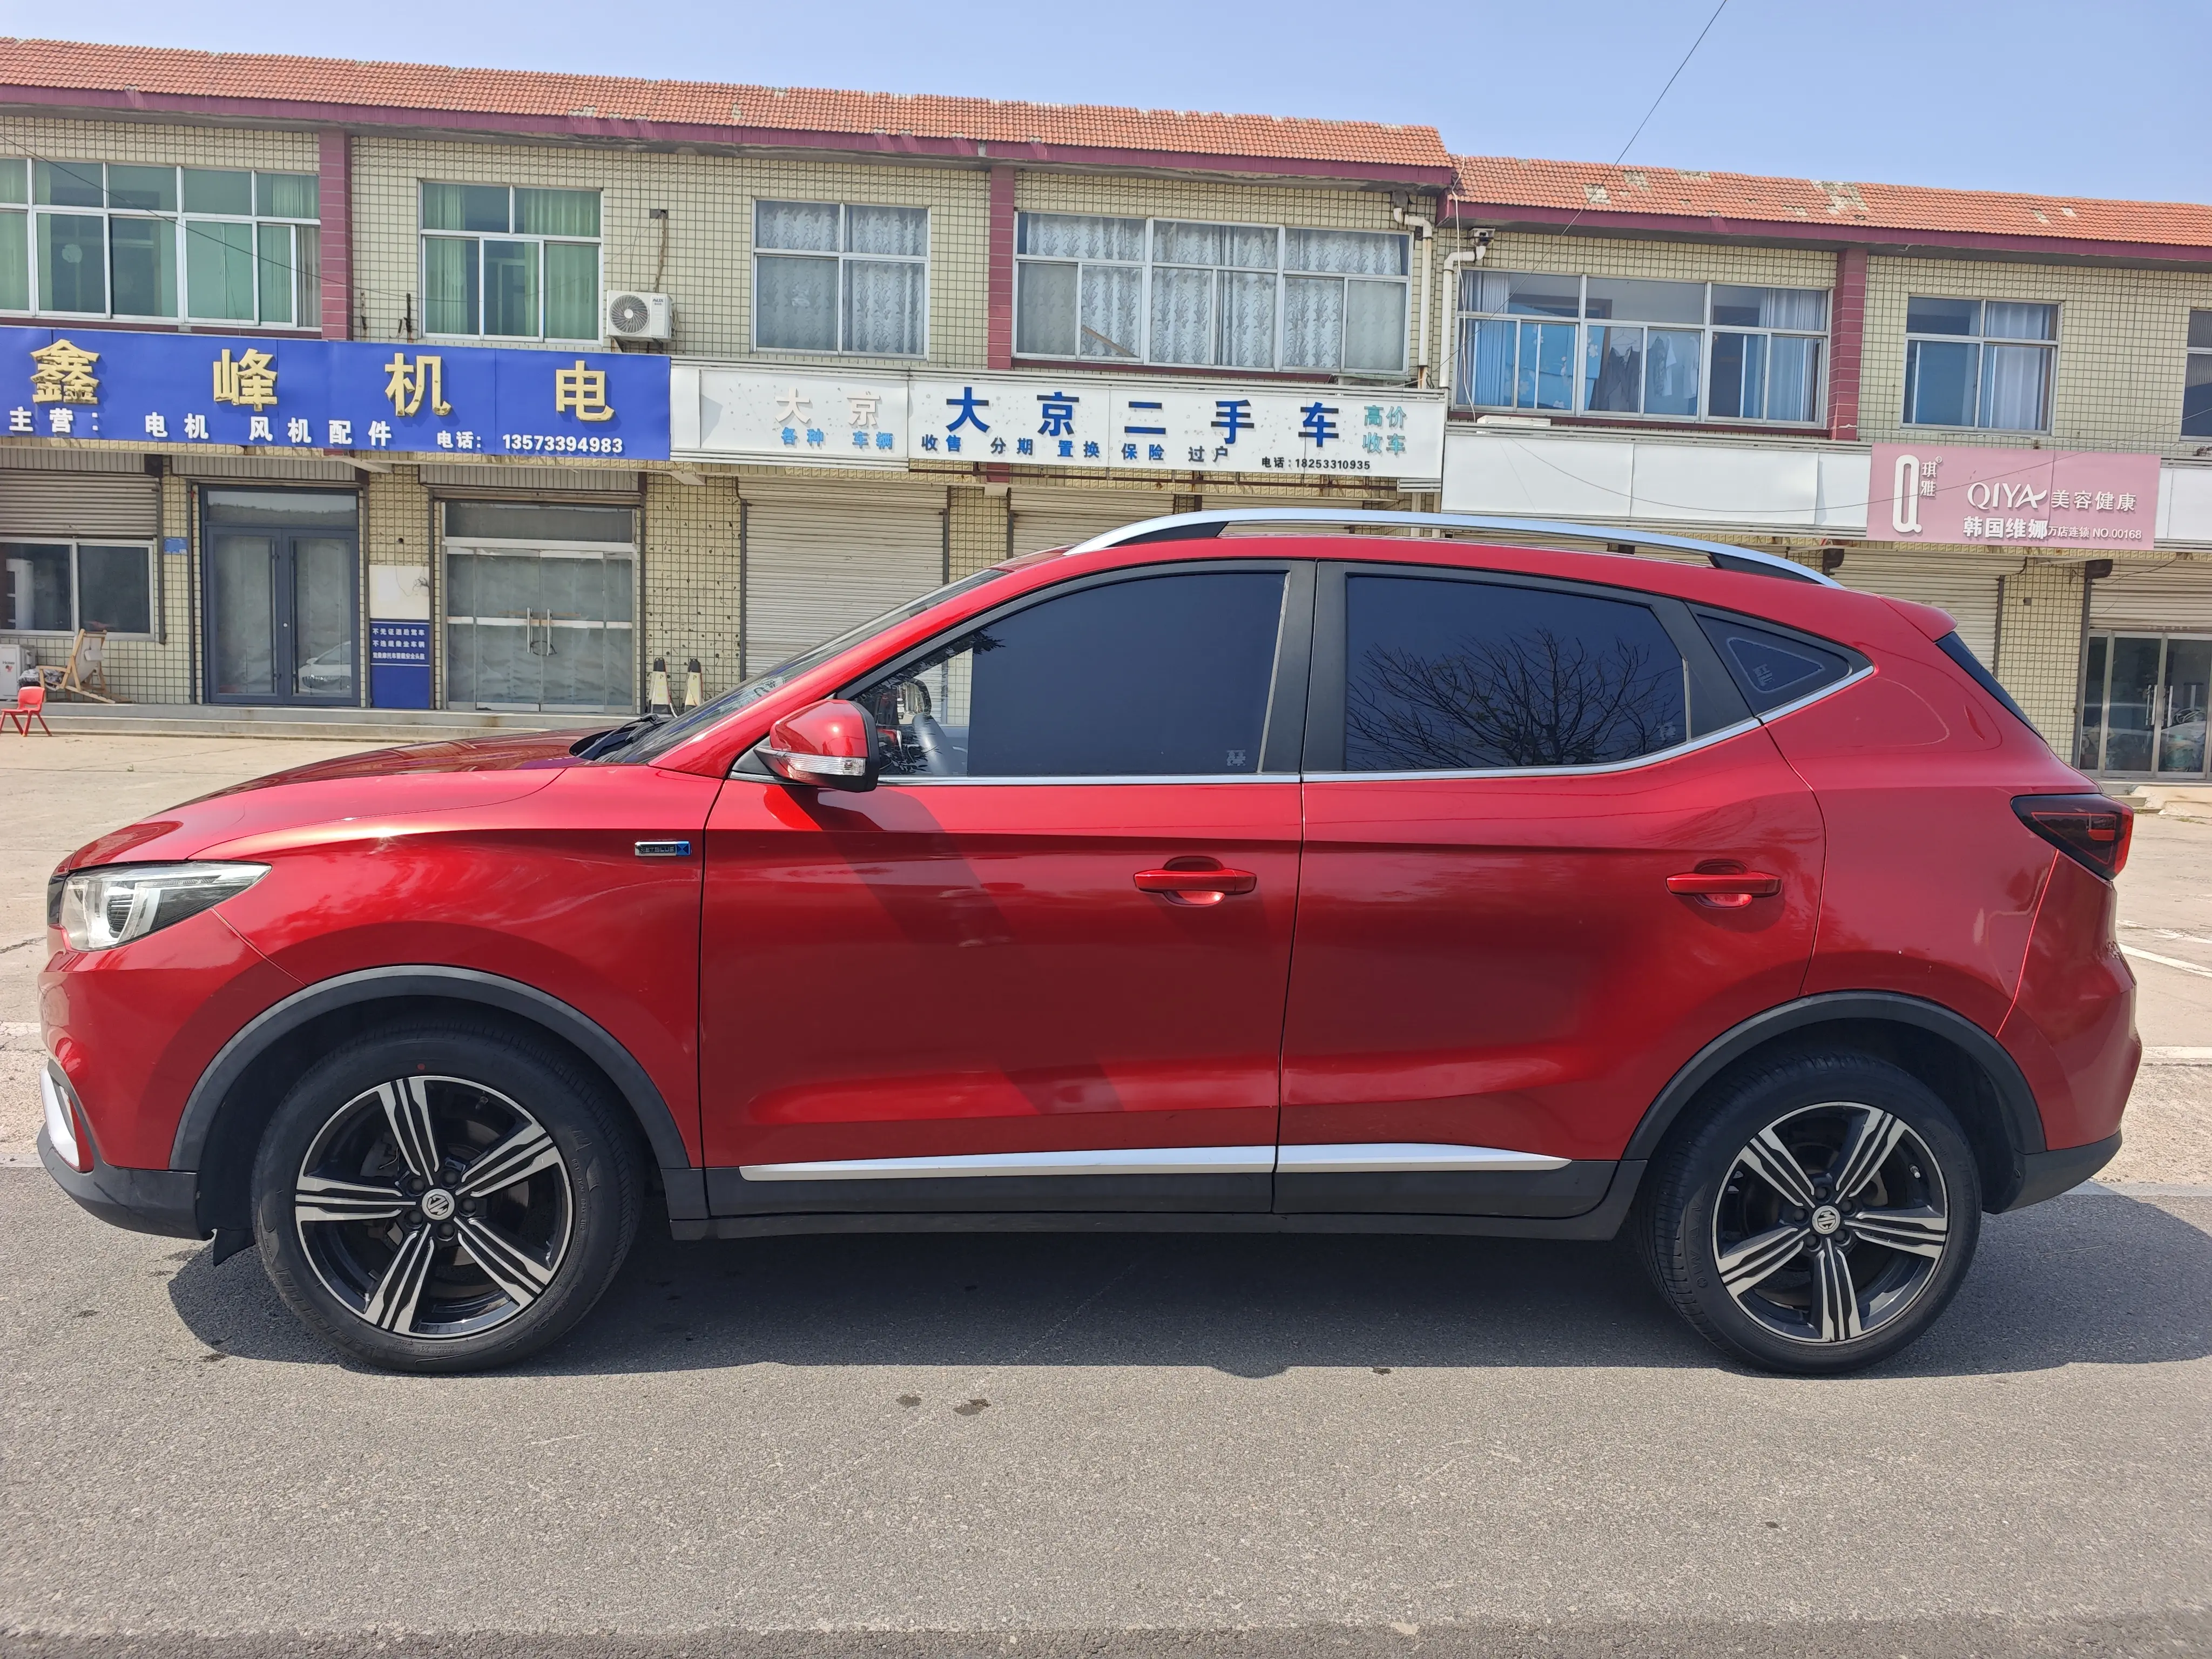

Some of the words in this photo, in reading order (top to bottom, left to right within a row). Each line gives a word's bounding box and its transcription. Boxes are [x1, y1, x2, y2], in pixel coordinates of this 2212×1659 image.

[30, 339, 615, 421] 鑫峰机电
[775, 387, 881, 426] 大京
[946, 387, 1339, 447] 大京二手车
[1364, 404, 1407, 429] 高价
[145, 412, 208, 440] 电机
[249, 416, 392, 447] 风机配件
[502, 434, 623, 454] 13573394983
[781, 427, 825, 446] 各种
[852, 431, 894, 450] 车辆
[1363, 432, 1406, 455] 收车
[921, 434, 962, 451] 收售
[990, 436, 1033, 456] 分期
[1057, 440, 1100, 458] 置换
[1121, 442, 1165, 461] 保险
[1188, 445, 1228, 462] 过户
[1919, 461, 1938, 496] 琪雅
[1967, 482, 2047, 510] QIYA
[2052, 489, 2136, 511] 美容健康
[1963, 516, 2049, 539] 韩国维娜
[2047, 525, 2090, 539] 万店连锁
[2093, 528, 2142, 539] NO.00168
